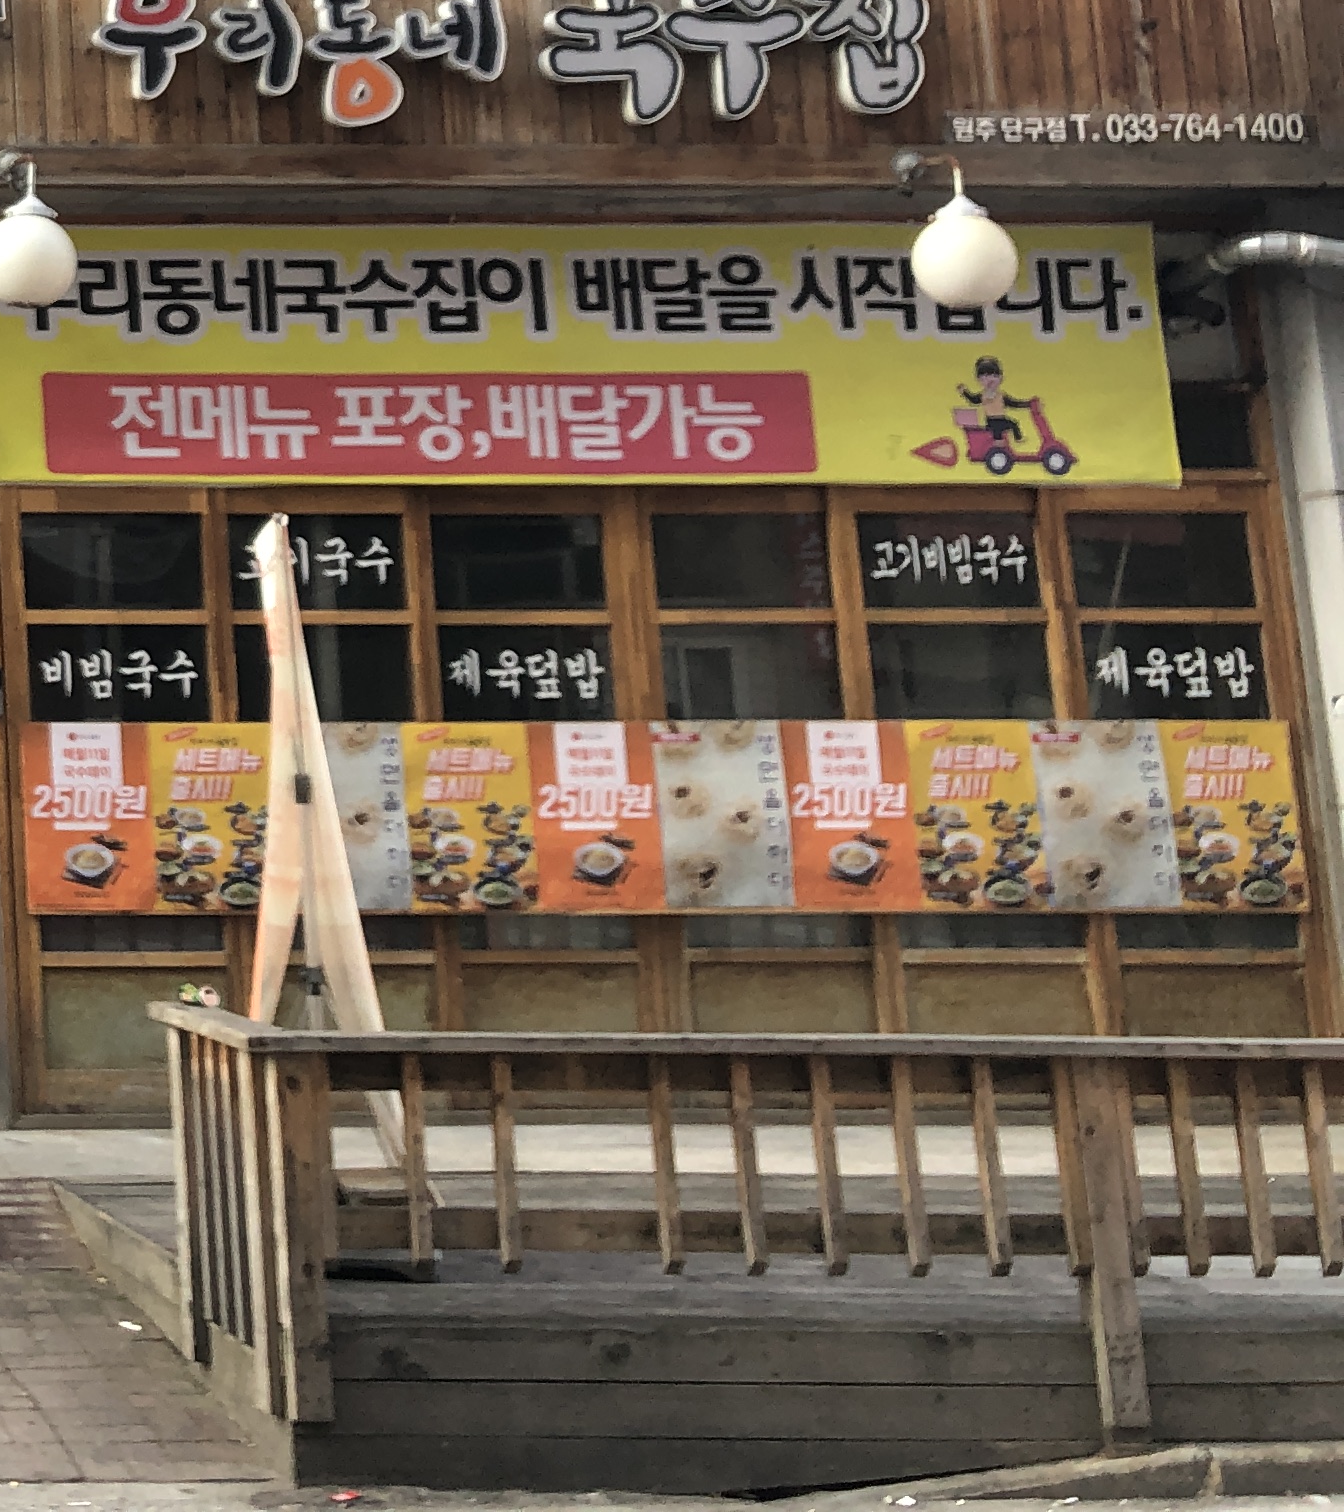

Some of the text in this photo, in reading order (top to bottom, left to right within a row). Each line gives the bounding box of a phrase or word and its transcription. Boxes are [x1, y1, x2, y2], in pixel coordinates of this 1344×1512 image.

[952, 116, 995, 144] 원주
[572, 255, 777, 334] 배달을
[110, 384, 320, 462] 전메뉴
[870, 534, 1028, 586] 고기비빔국수
[39, 649, 200, 700] 비빔국수
[446, 647, 605, 700] 제육덮밥
[1096, 646, 1255, 700] 제육덮밥
[172, 747, 265, 774] 세트메뉴
[426, 746, 516, 774] 세트메뉴
[930, 744, 1022, 773] 세트메뉴
[1184, 744, 1275, 773] 세트메뉴
[31, 783, 148, 820] 2500원
[537, 783, 653, 820] 2500원
[791, 782, 907, 818] 2500원
